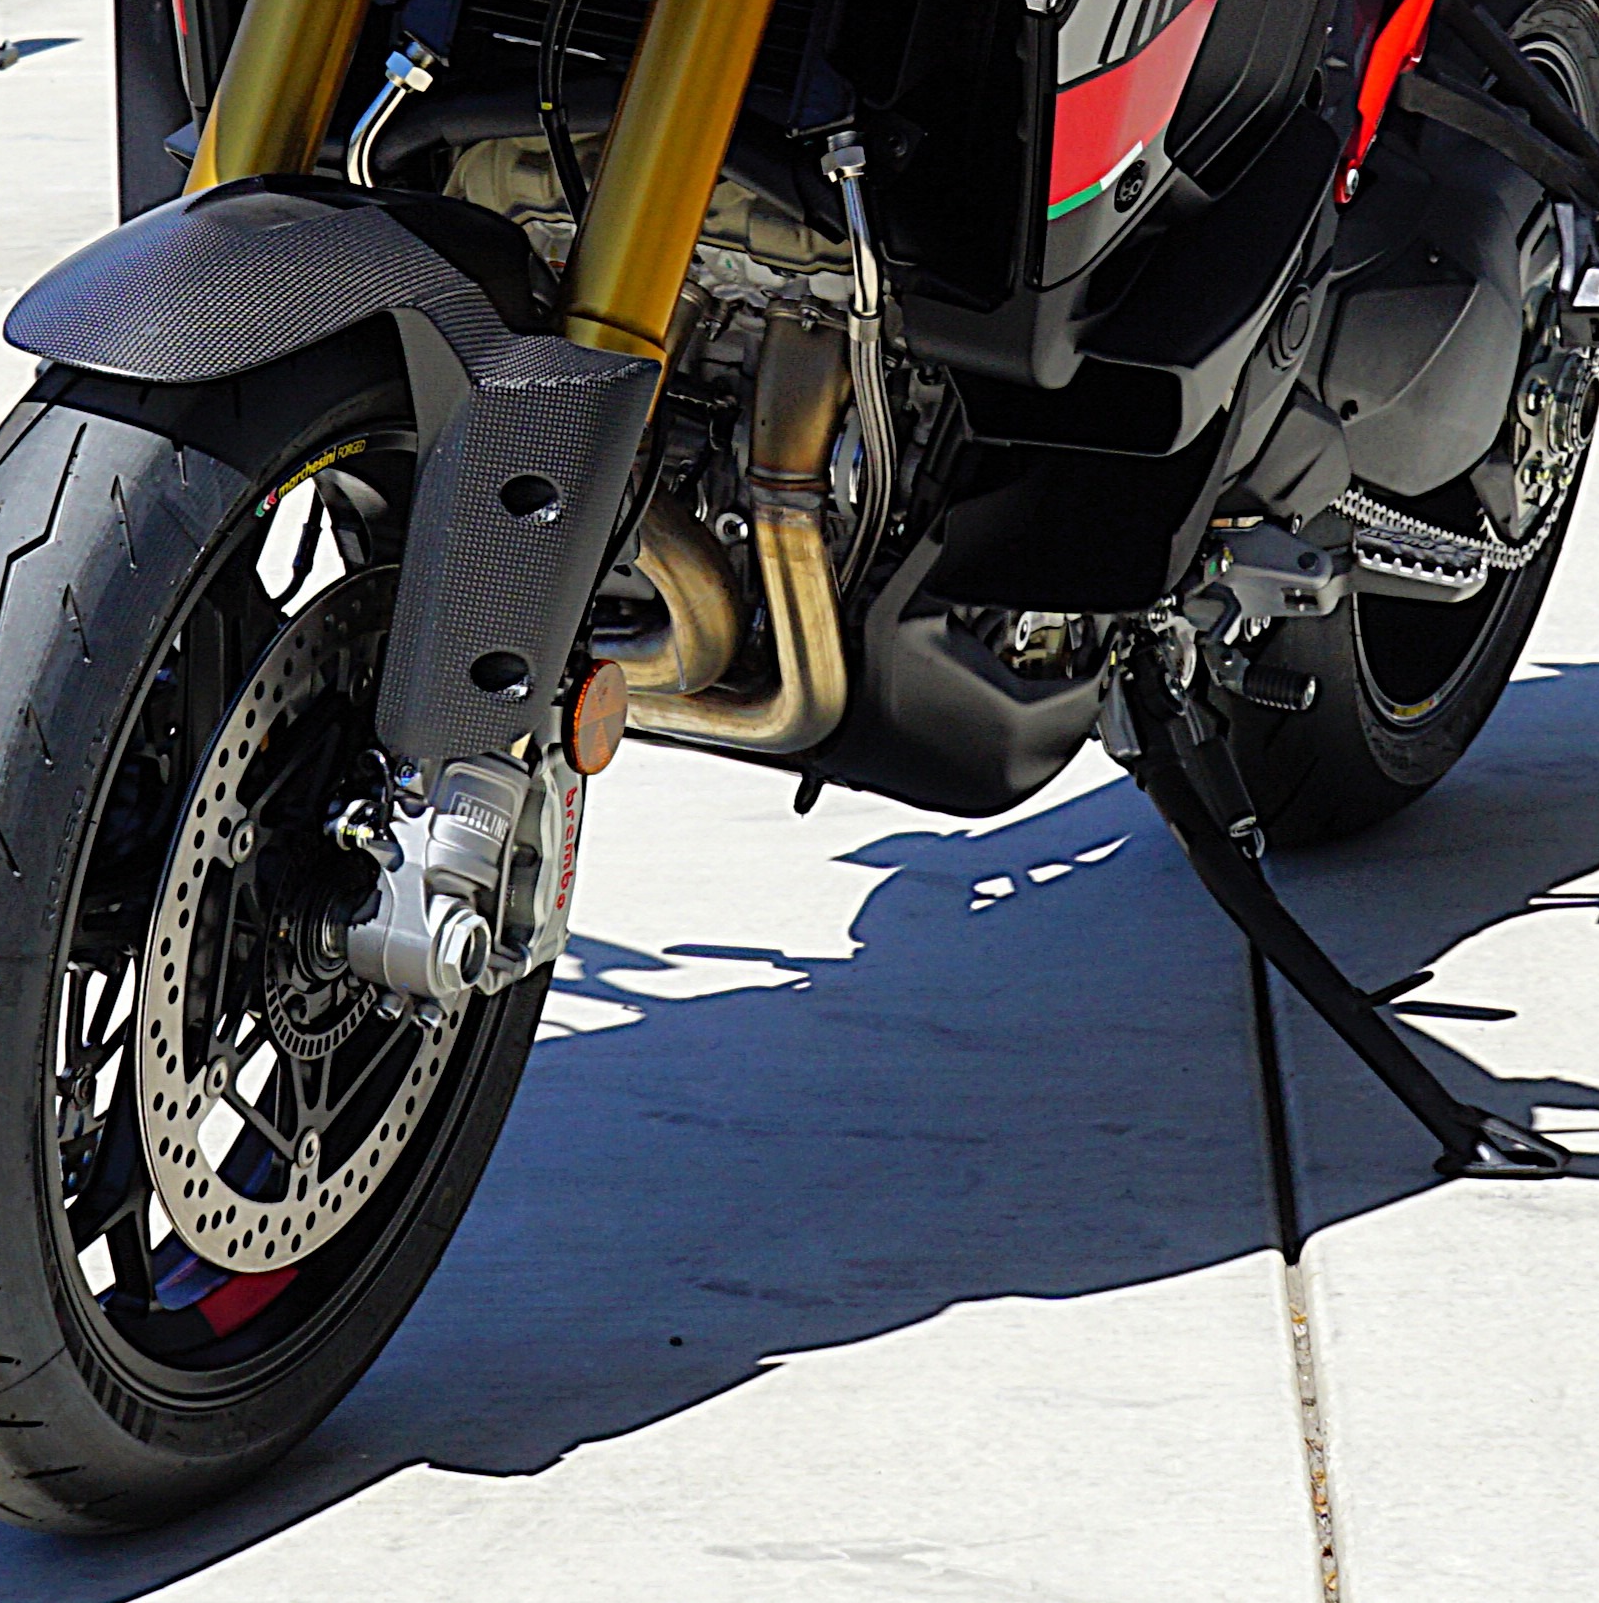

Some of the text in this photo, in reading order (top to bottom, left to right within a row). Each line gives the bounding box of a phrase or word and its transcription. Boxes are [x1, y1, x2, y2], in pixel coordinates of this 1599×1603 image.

[278, 439, 366, 499] marchesini FORGED
[555, 787, 578, 910] brembo
